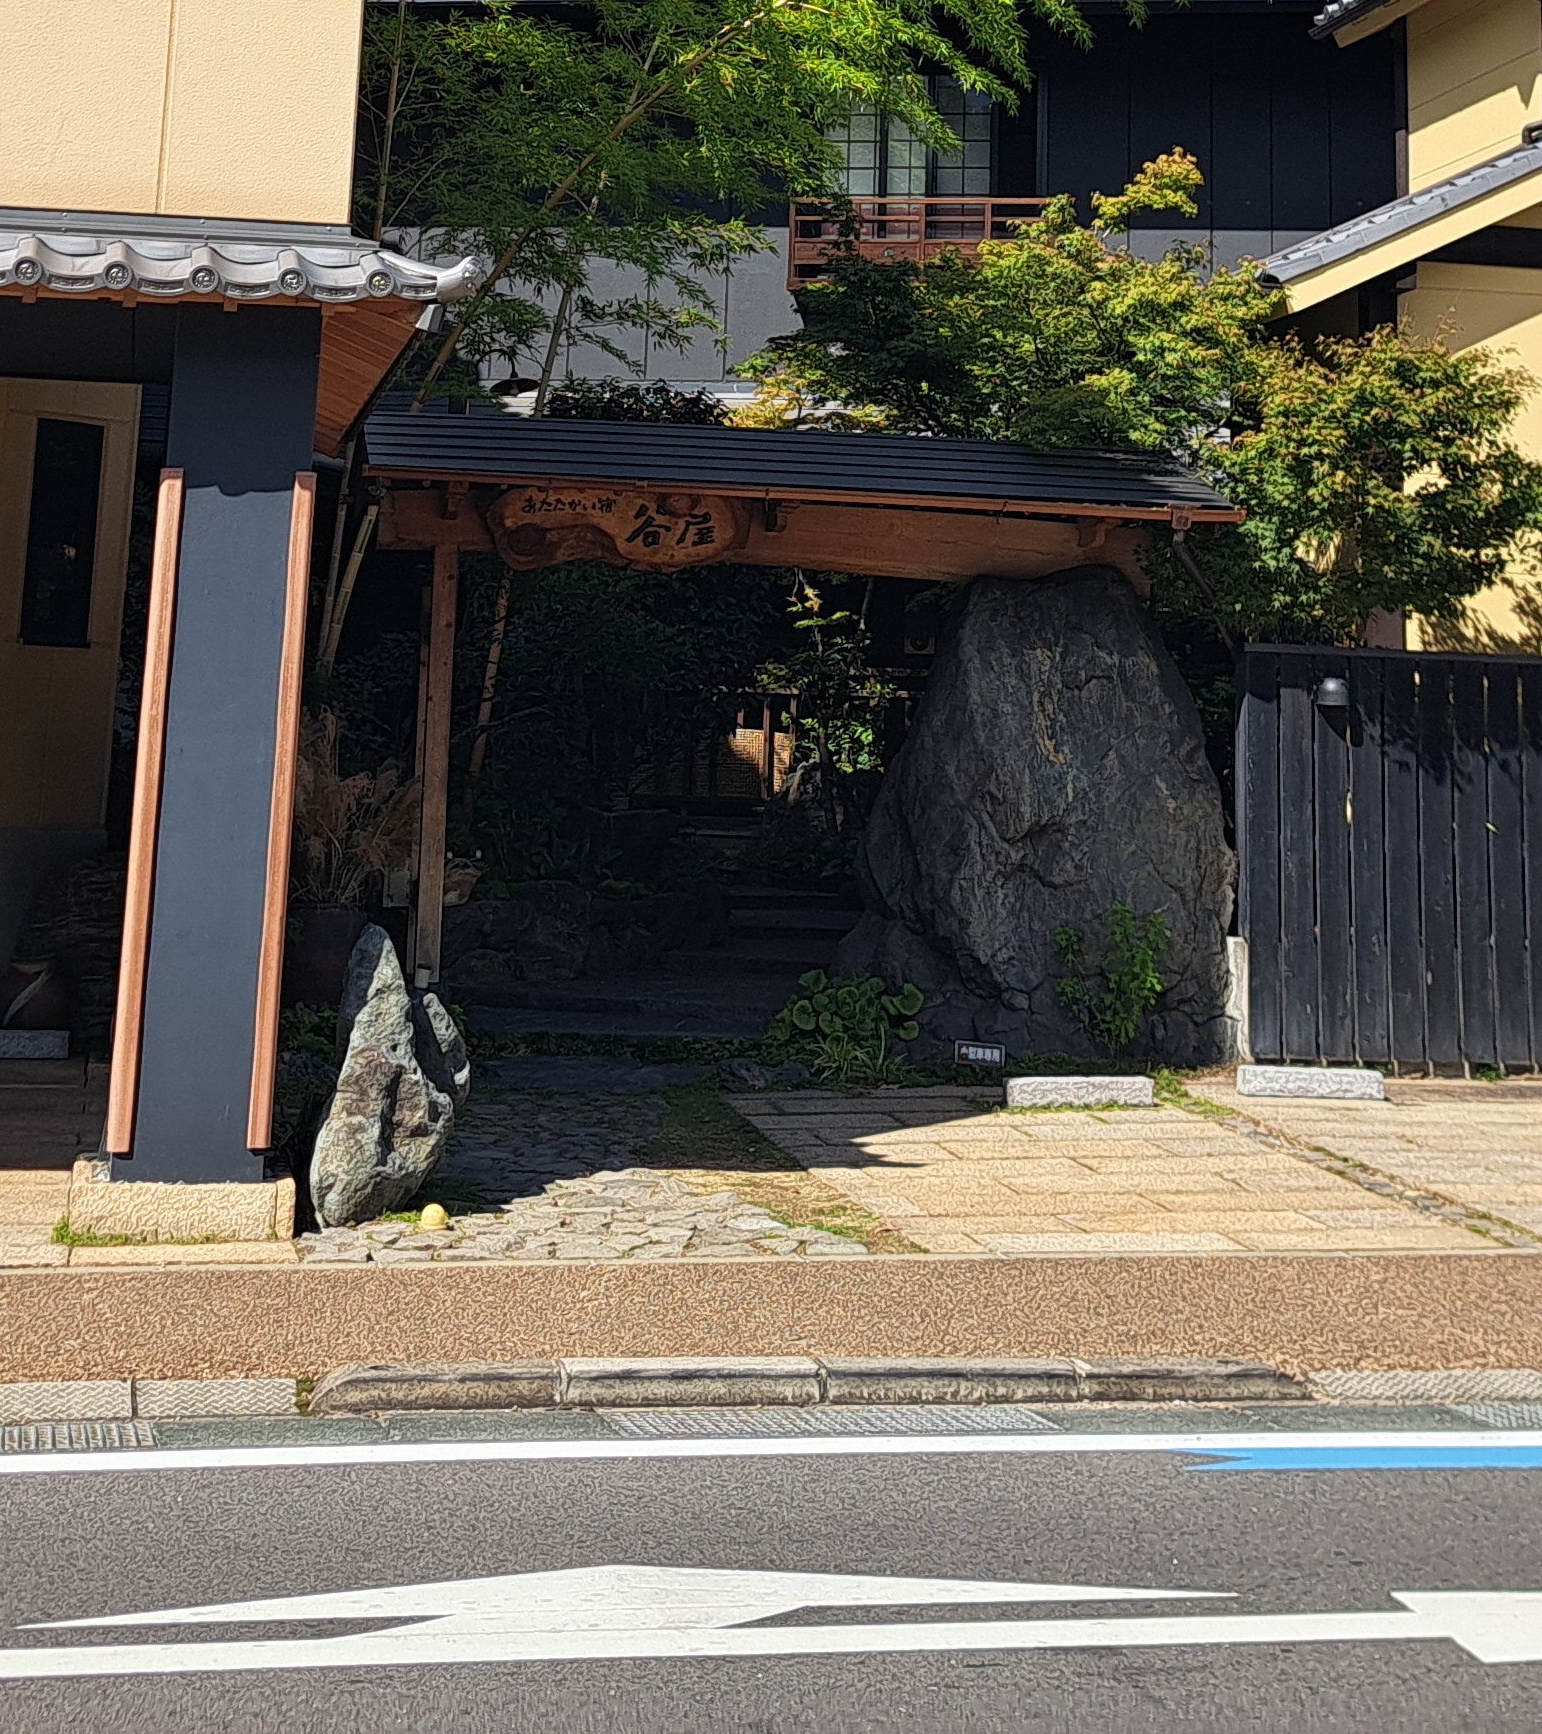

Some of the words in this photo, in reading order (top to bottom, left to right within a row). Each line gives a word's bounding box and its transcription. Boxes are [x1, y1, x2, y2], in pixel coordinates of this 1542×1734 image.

[521, 494, 617, 514] あたたかい宿
[625, 503, 716, 548] 谷屋
